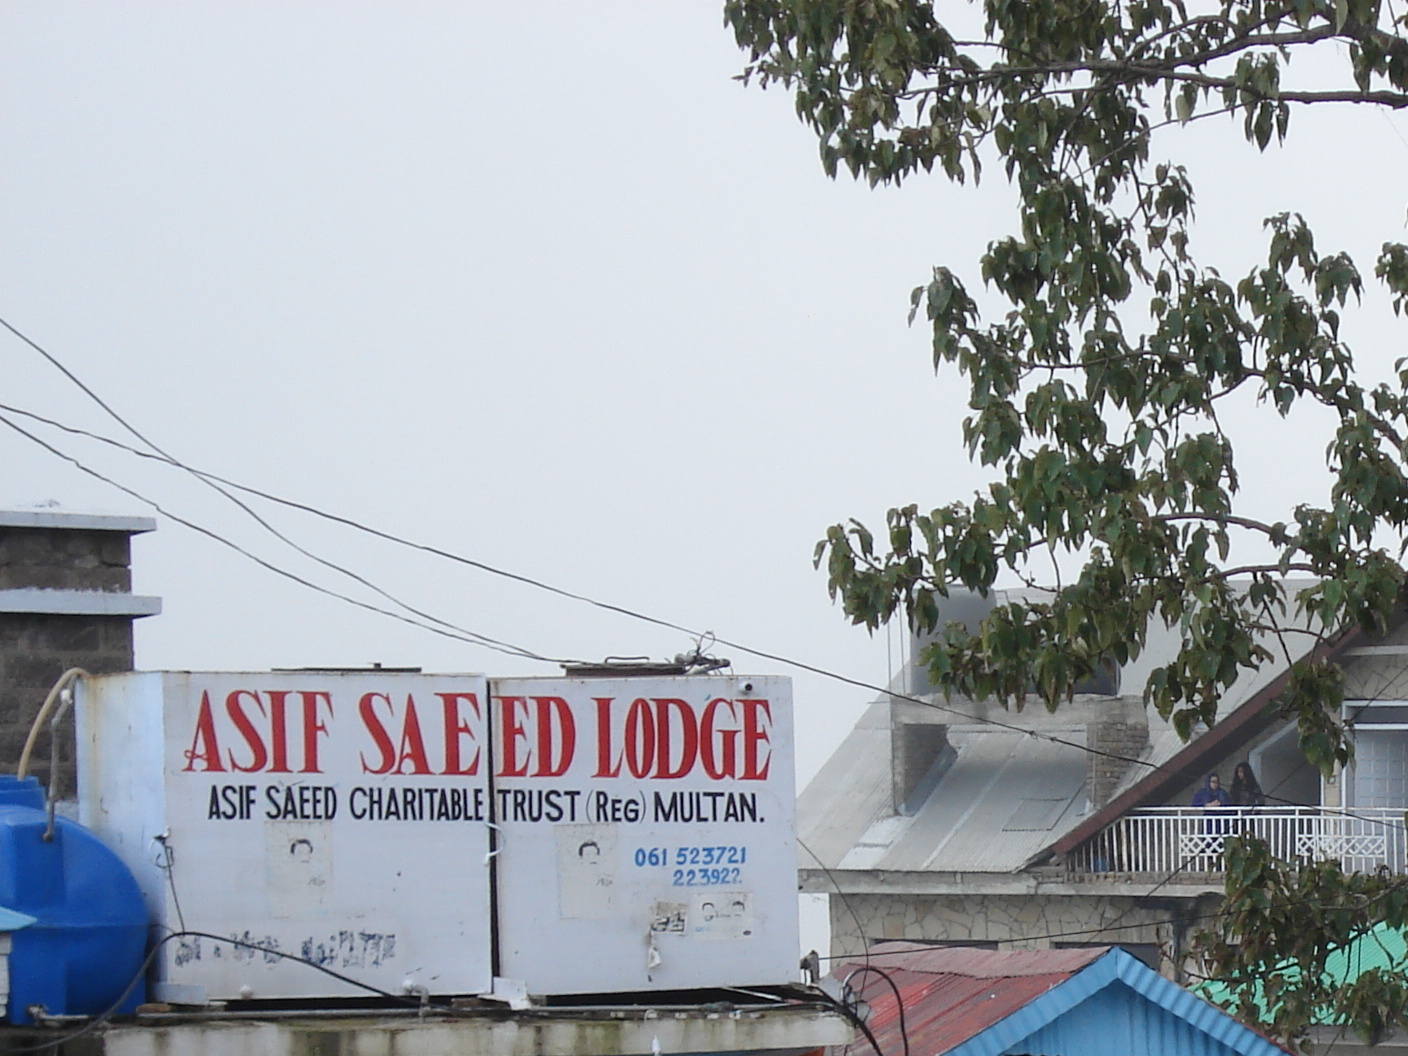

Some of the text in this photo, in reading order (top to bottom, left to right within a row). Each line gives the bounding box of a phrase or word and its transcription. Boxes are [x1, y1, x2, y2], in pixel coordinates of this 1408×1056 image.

[182, 689, 334, 774] ASIF
[591, 697, 773, 781] LODGE
[207, 785, 257, 820] ASIF
[265, 785, 338, 821] SAEED
[349, 787, 484, 821] CHARITABLE
[497, 789, 581, 822] TRUST
[654, 791, 766, 823] MULTAN.
[634, 846, 747, 867] 061 523721
